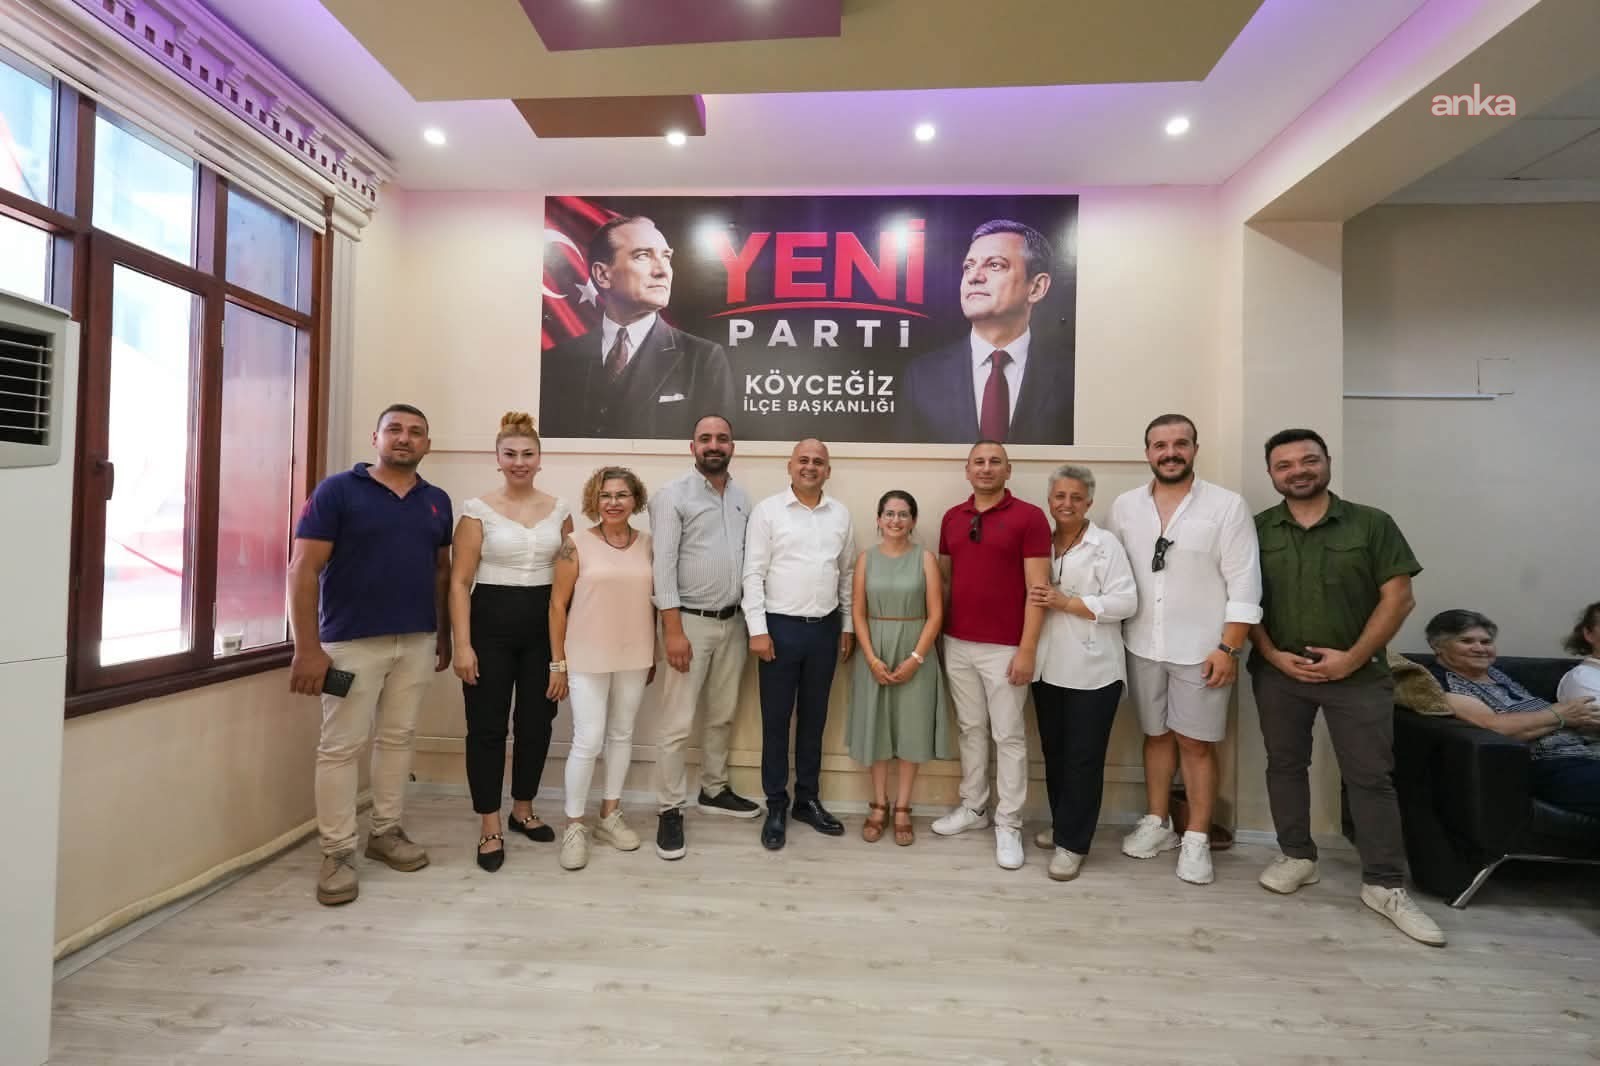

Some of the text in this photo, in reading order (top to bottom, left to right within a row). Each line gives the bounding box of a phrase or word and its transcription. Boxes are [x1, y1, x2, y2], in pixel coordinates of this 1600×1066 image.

[745, 369, 894, 396] KÖYCEĞİZ
[743, 396, 895, 416] İLÇE BAŞKANLIĞI
